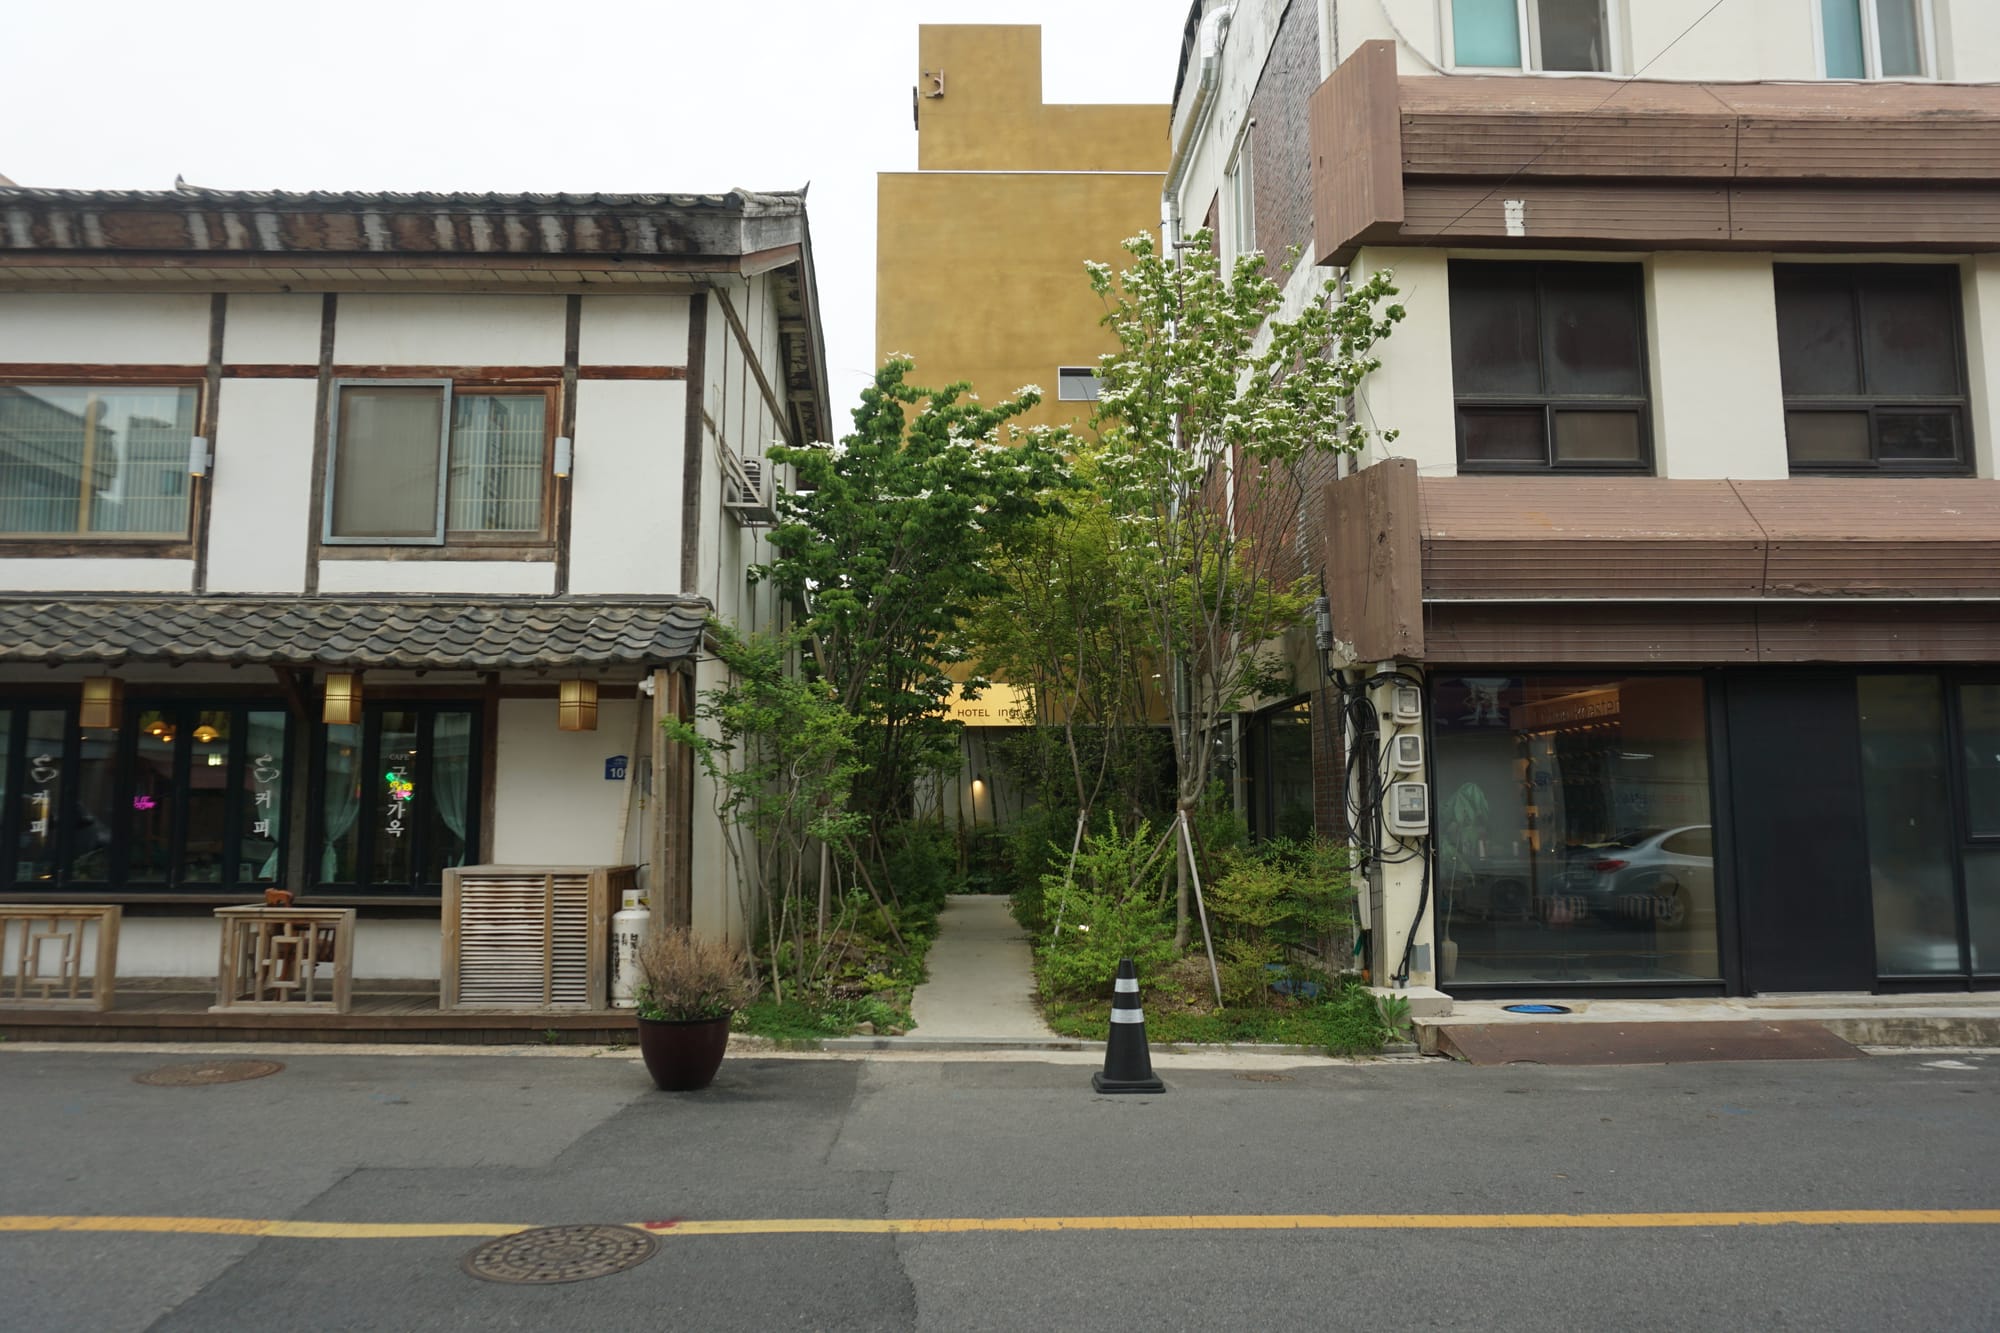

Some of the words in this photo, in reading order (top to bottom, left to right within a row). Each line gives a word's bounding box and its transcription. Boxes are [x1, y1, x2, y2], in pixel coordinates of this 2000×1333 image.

[957, 708, 990, 717] HOTEL
[388, 753, 410, 761] CAFE
[30, 790, 49, 837] 커피
[253, 790, 271, 838] 커피
